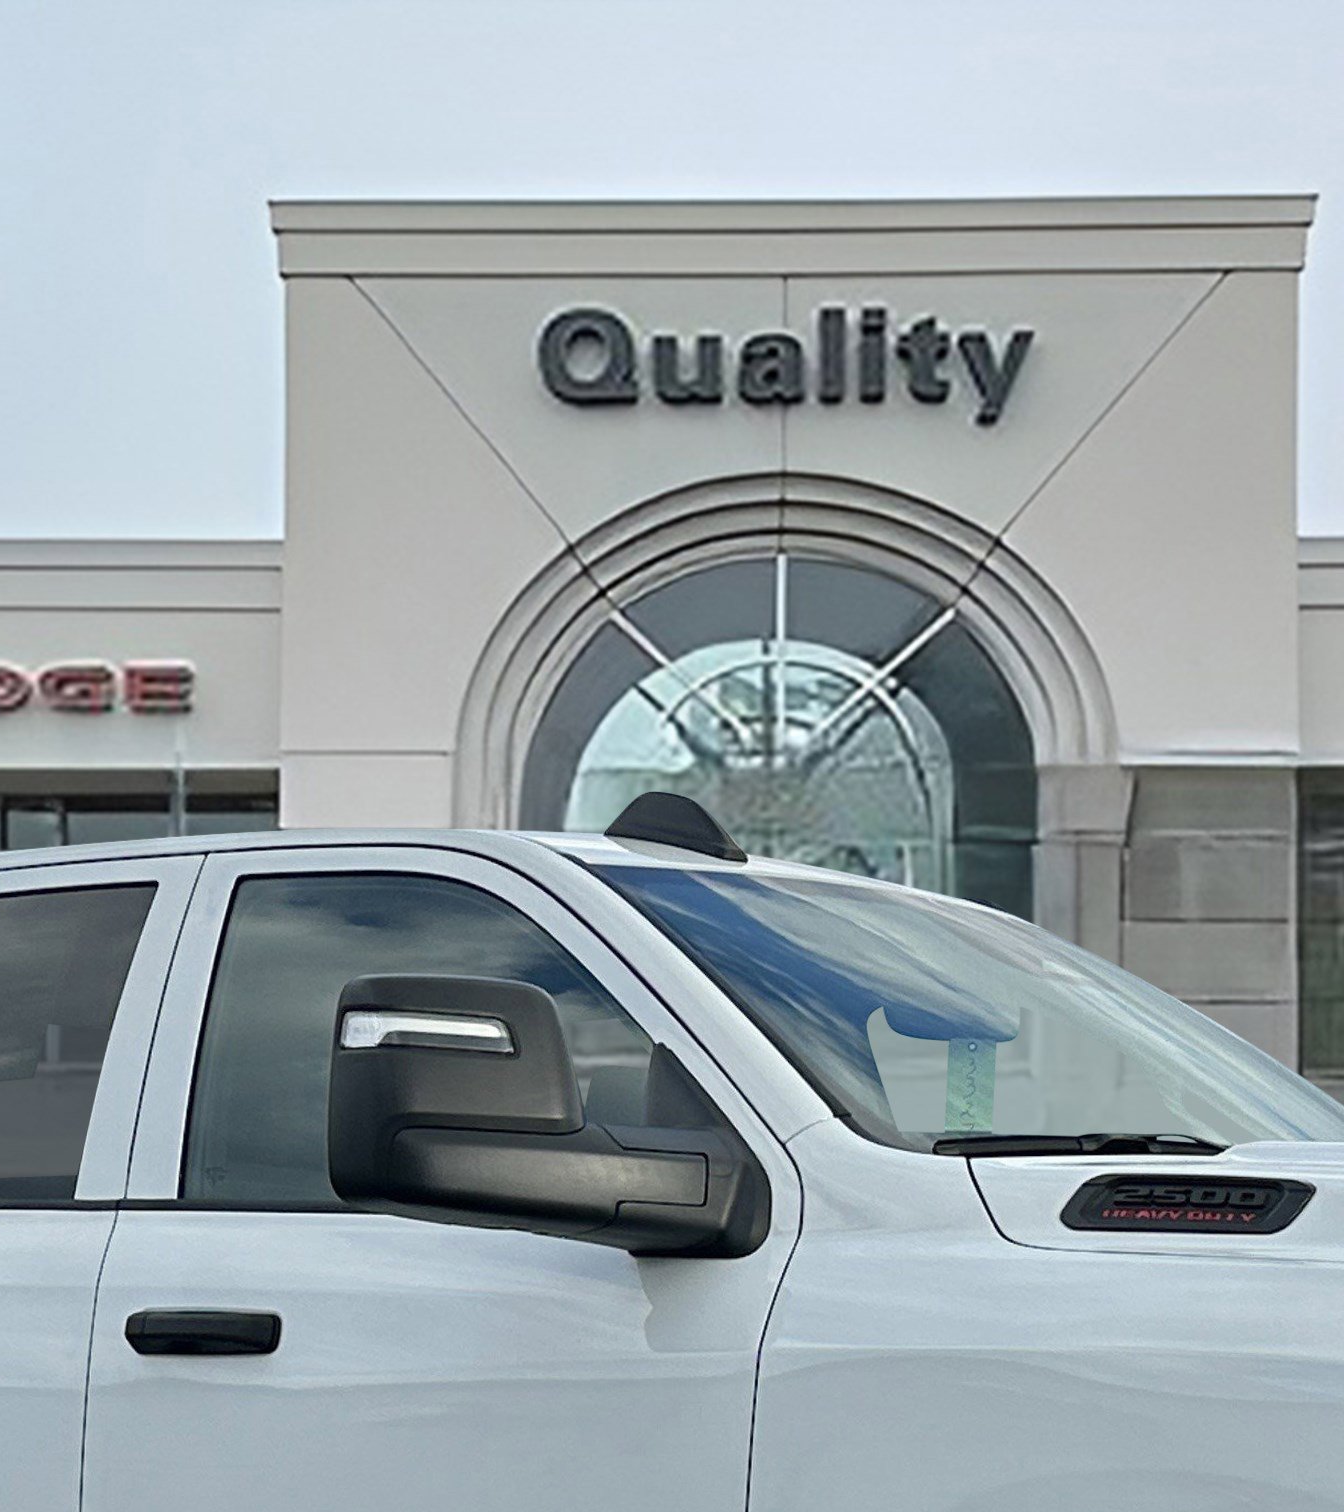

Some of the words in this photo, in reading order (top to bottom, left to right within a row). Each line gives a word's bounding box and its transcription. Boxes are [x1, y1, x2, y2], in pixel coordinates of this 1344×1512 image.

[538, 306, 1034, 427] Quality
[1112, 1184, 1269, 1210] 2500
[1101, 1207, 1183, 1221] HEAVY
[1185, 1210, 1257, 1223] DUTY
